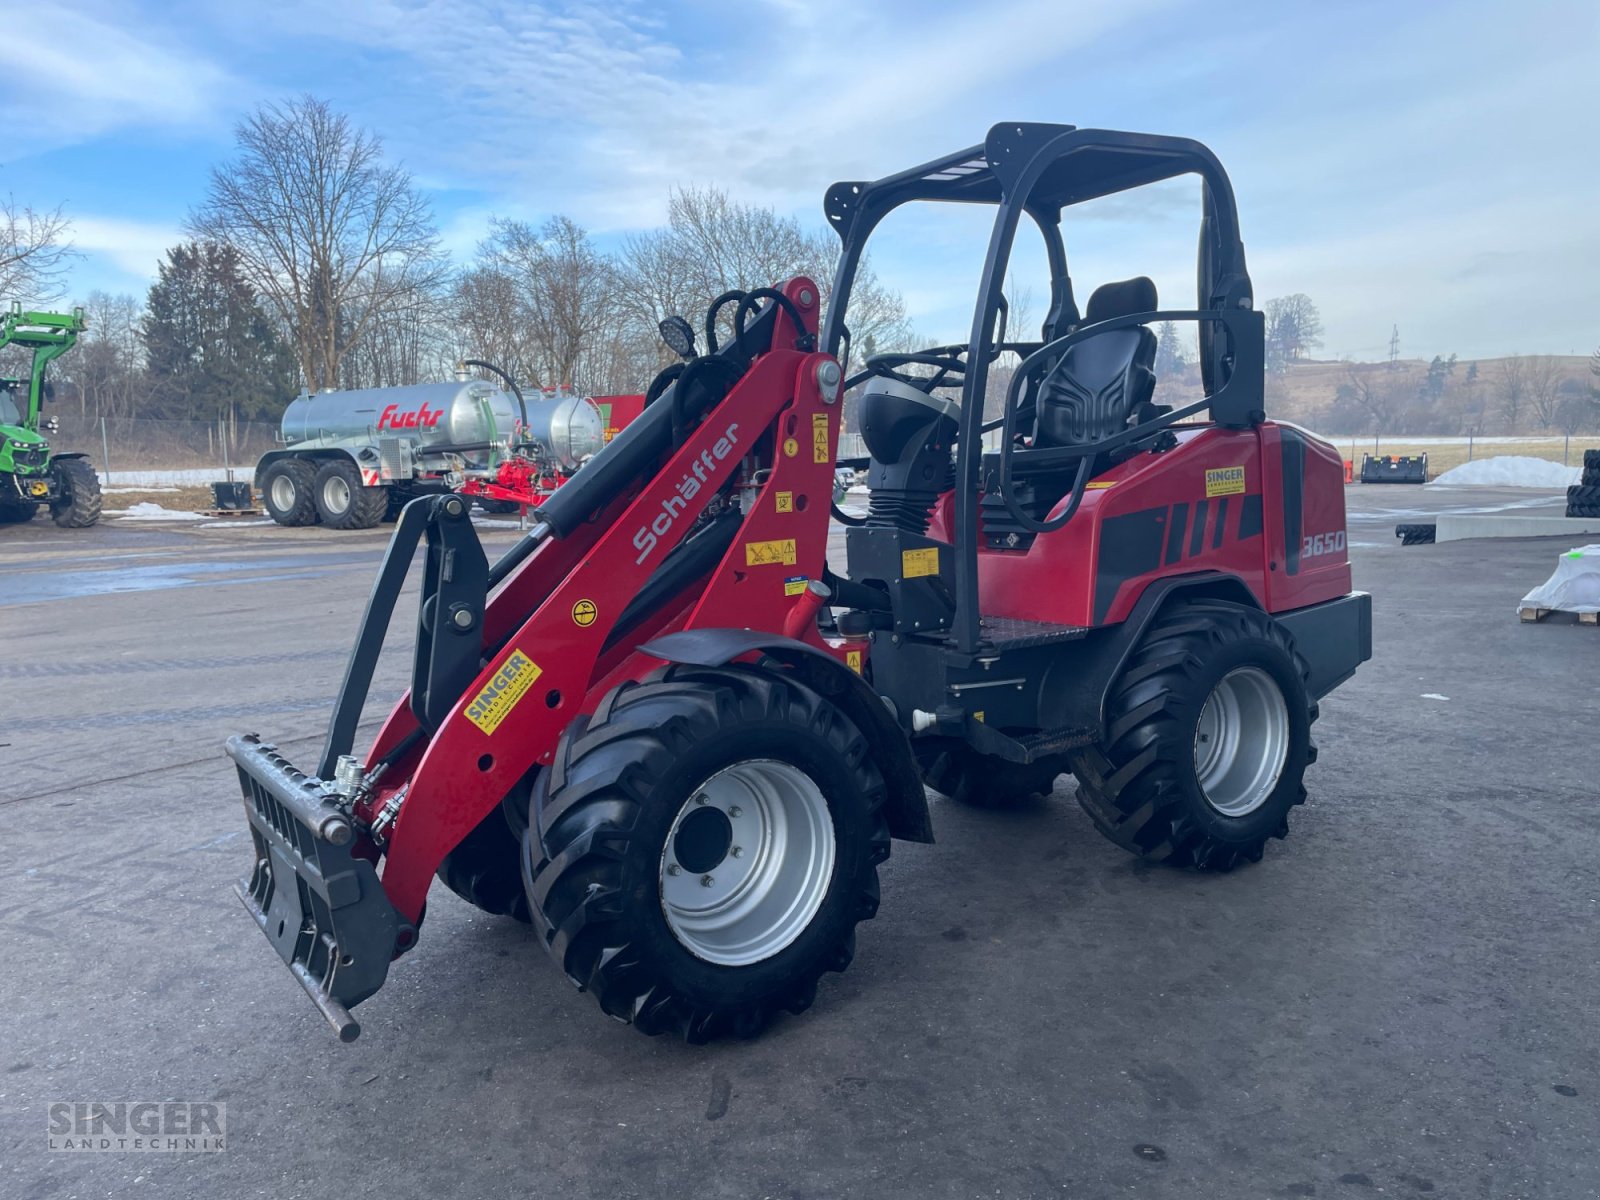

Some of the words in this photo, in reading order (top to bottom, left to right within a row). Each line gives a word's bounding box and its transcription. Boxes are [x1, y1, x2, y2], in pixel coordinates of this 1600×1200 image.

[378, 402, 444, 431] Fuchs
[633, 423, 738, 565] Schäffer
[1207, 469, 1243, 483] SINGER
[1302, 531, 1345, 559] 3650
[468, 655, 527, 721] SINGER
[478, 662, 532, 725] LANDTECHNIK
